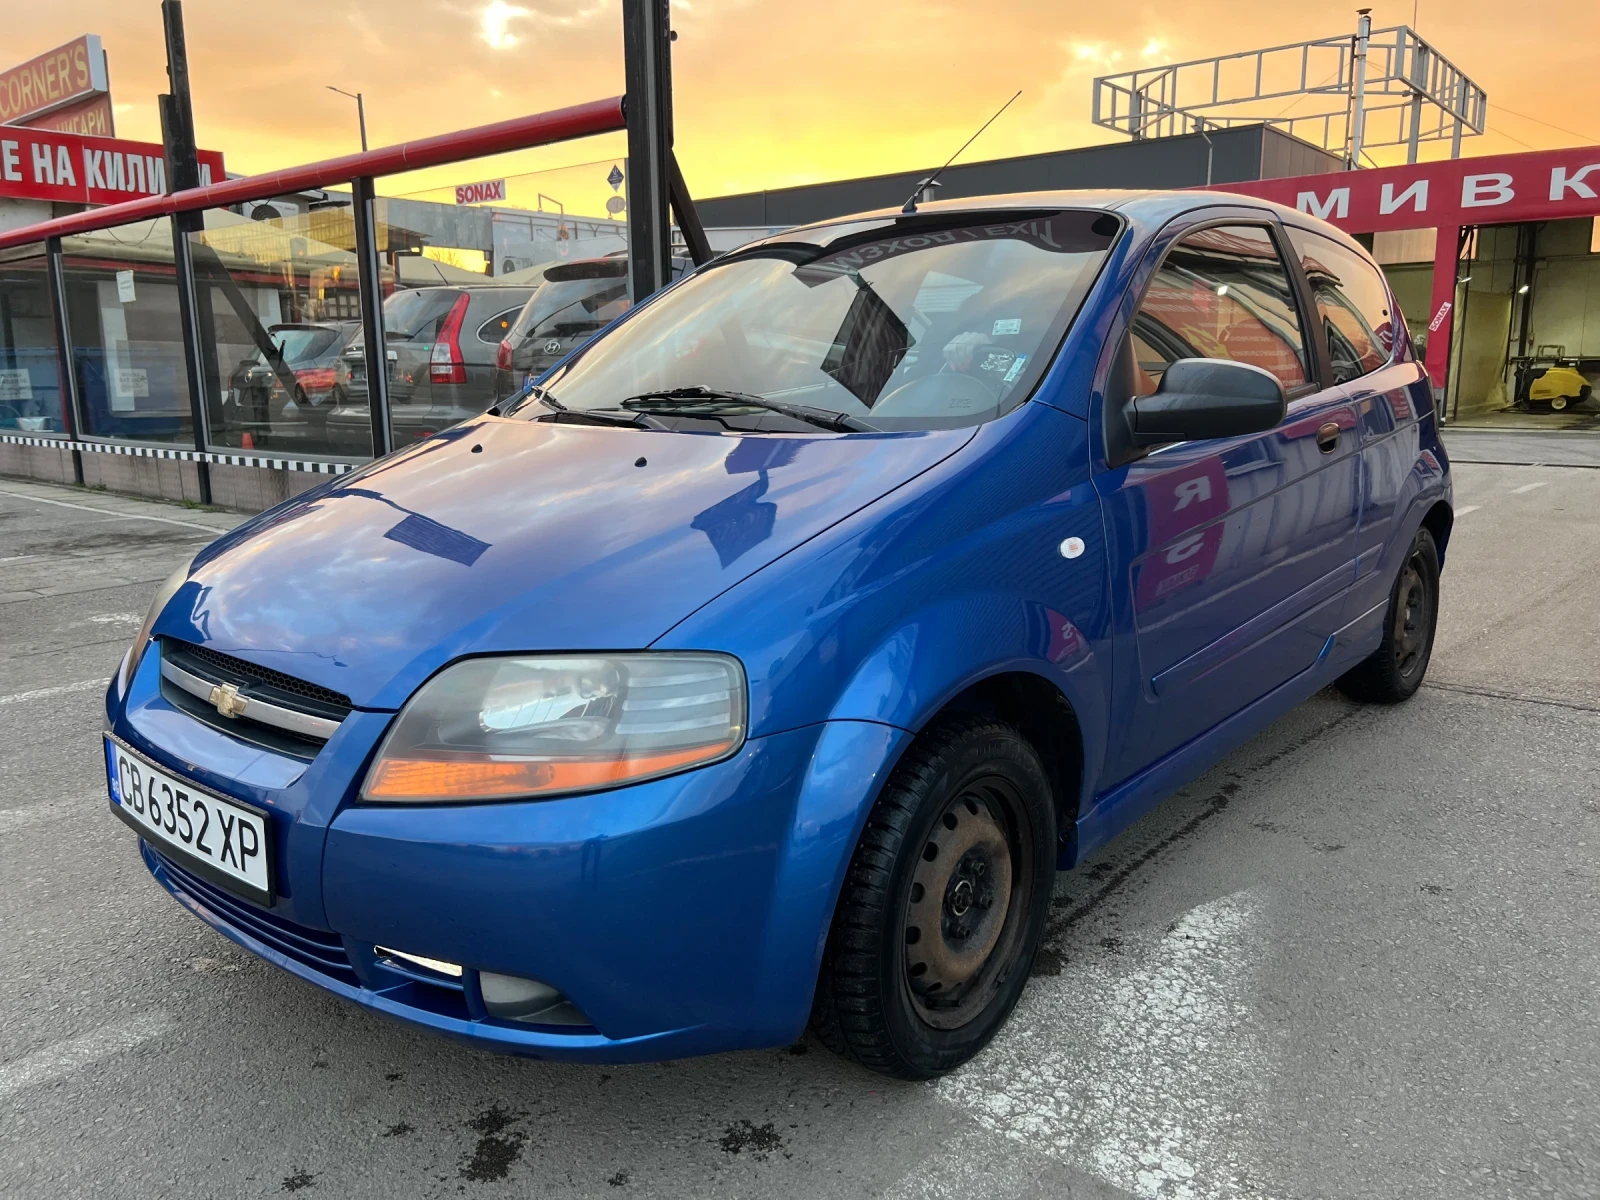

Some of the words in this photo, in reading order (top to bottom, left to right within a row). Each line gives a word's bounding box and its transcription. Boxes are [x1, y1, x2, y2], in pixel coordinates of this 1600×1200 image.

[0, 45, 89, 119] CORNER'S
[31, 142, 77, 187] НА
[456, 181, 502, 204] SONAX
[1430, 304, 1450, 330] SONAX
